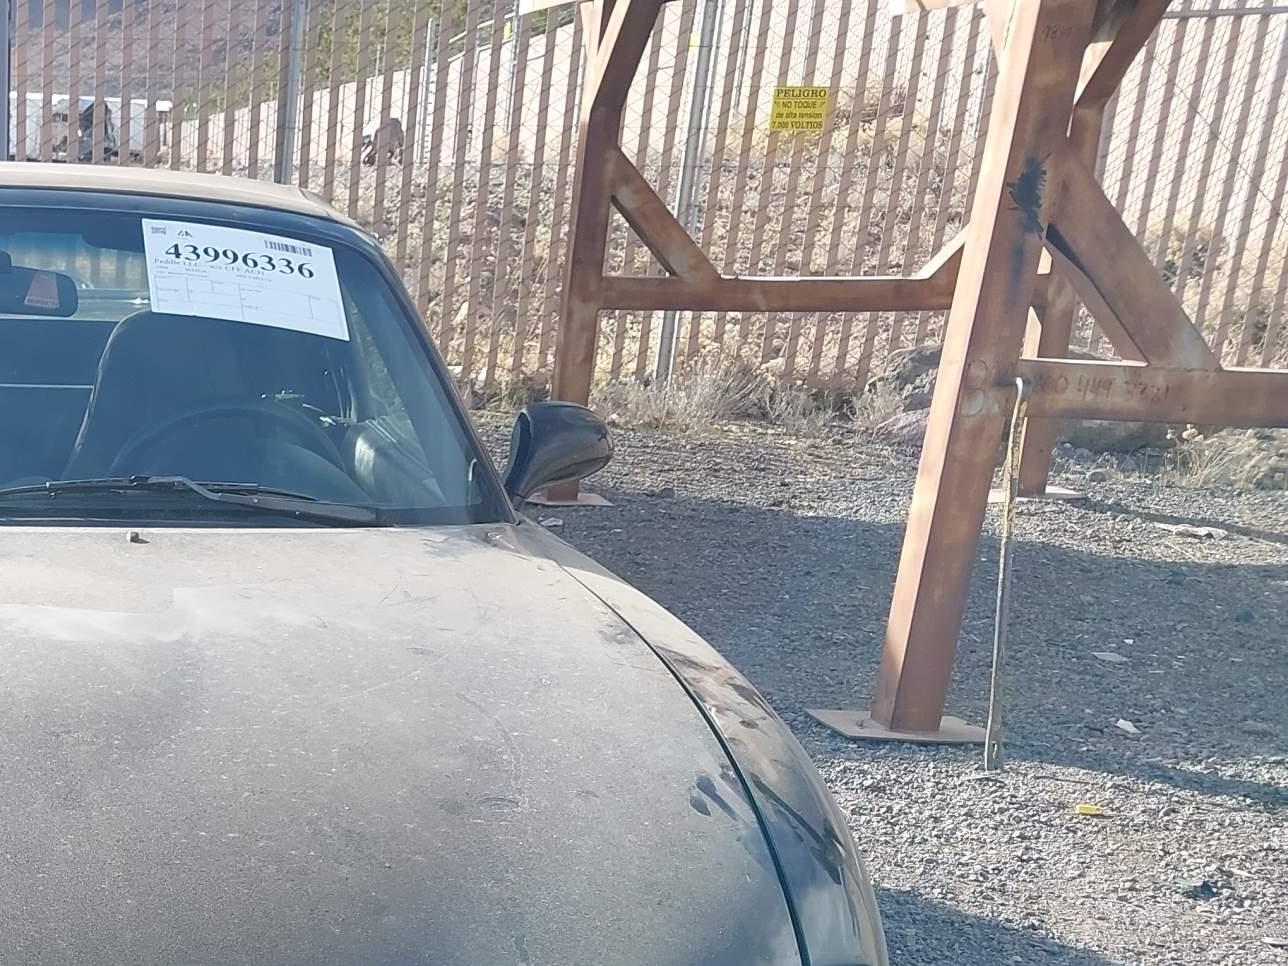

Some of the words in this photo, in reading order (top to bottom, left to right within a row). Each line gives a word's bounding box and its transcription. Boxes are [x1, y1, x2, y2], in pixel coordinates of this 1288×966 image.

[776, 89, 827, 98] PELIGRO
[782, 101, 792, 109] NO
[794, 101, 817, 109] TOQUE
[791, 121, 824, 130] VOLTIOS
[165, 243, 314, 279] 43996336
